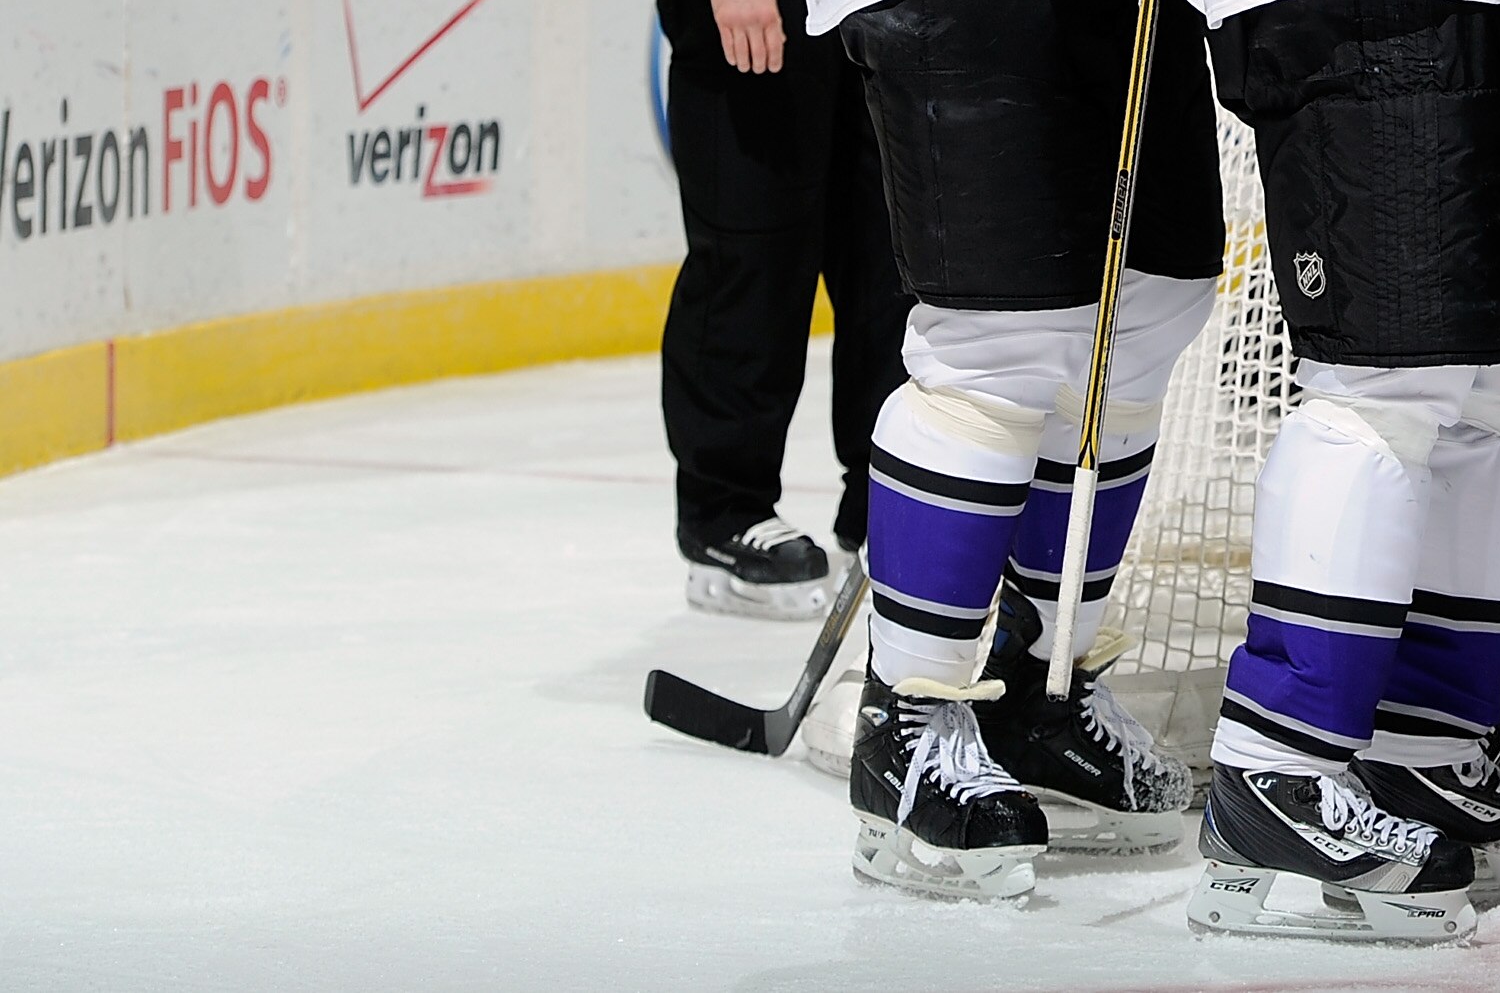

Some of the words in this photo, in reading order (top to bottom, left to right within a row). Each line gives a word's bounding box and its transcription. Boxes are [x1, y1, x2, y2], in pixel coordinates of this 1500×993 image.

[348, 104, 501, 199] verizon
[1112, 174, 1129, 234] BAUER
[1301, 263, 1319, 289] NHL
[1064, 749, 1102, 777] BAUER
[883, 770, 907, 795] BAU
[1461, 801, 1497, 817] CCM
[868, 828, 887, 840] TUK
[1313, 836, 1349, 856] CCM
[1210, 882, 1252, 894] CCM
